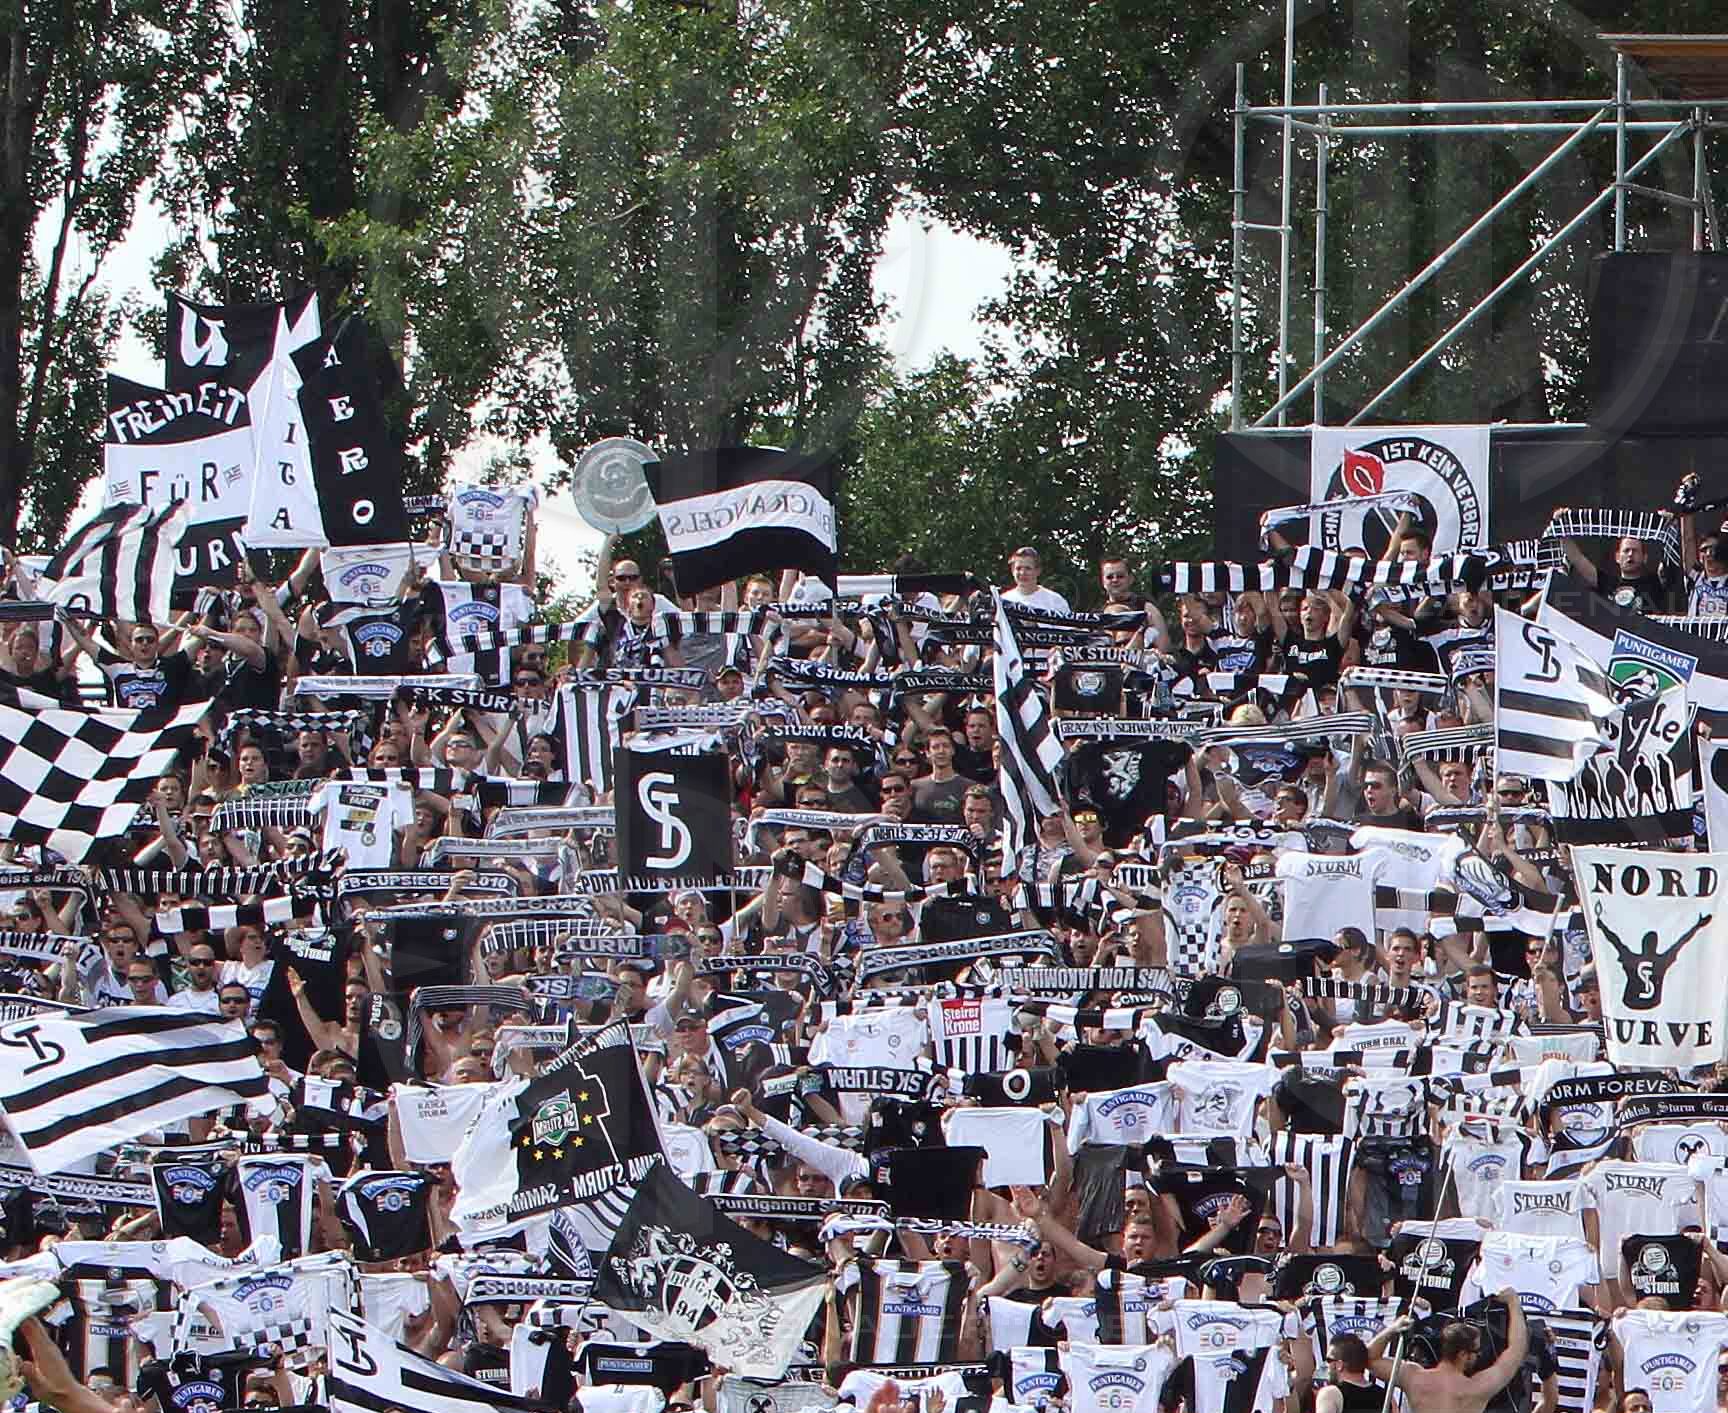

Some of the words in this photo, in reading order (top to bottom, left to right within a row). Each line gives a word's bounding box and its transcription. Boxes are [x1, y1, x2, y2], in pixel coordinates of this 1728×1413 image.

[1382, 442, 1413, 461] IST
[1417, 446, 1453, 478] KEIN
[140, 462, 219, 506] FÜR
[1615, 635, 1692, 672] PUNTIGAMER
[1306, 858, 1363, 877] STURM
[1591, 862, 1718, 898] NORD
[943, 1019, 981, 1034] Krone
[1604, 1172, 1667, 1199] STURM
[714, 1196, 816, 1216] Puntigamer
[1513, 1191, 1573, 1214] STURM
[883, 1303, 942, 1315] PUNTIGAMER
[1088, 1372, 1145, 1393] PUNTIGAMER
